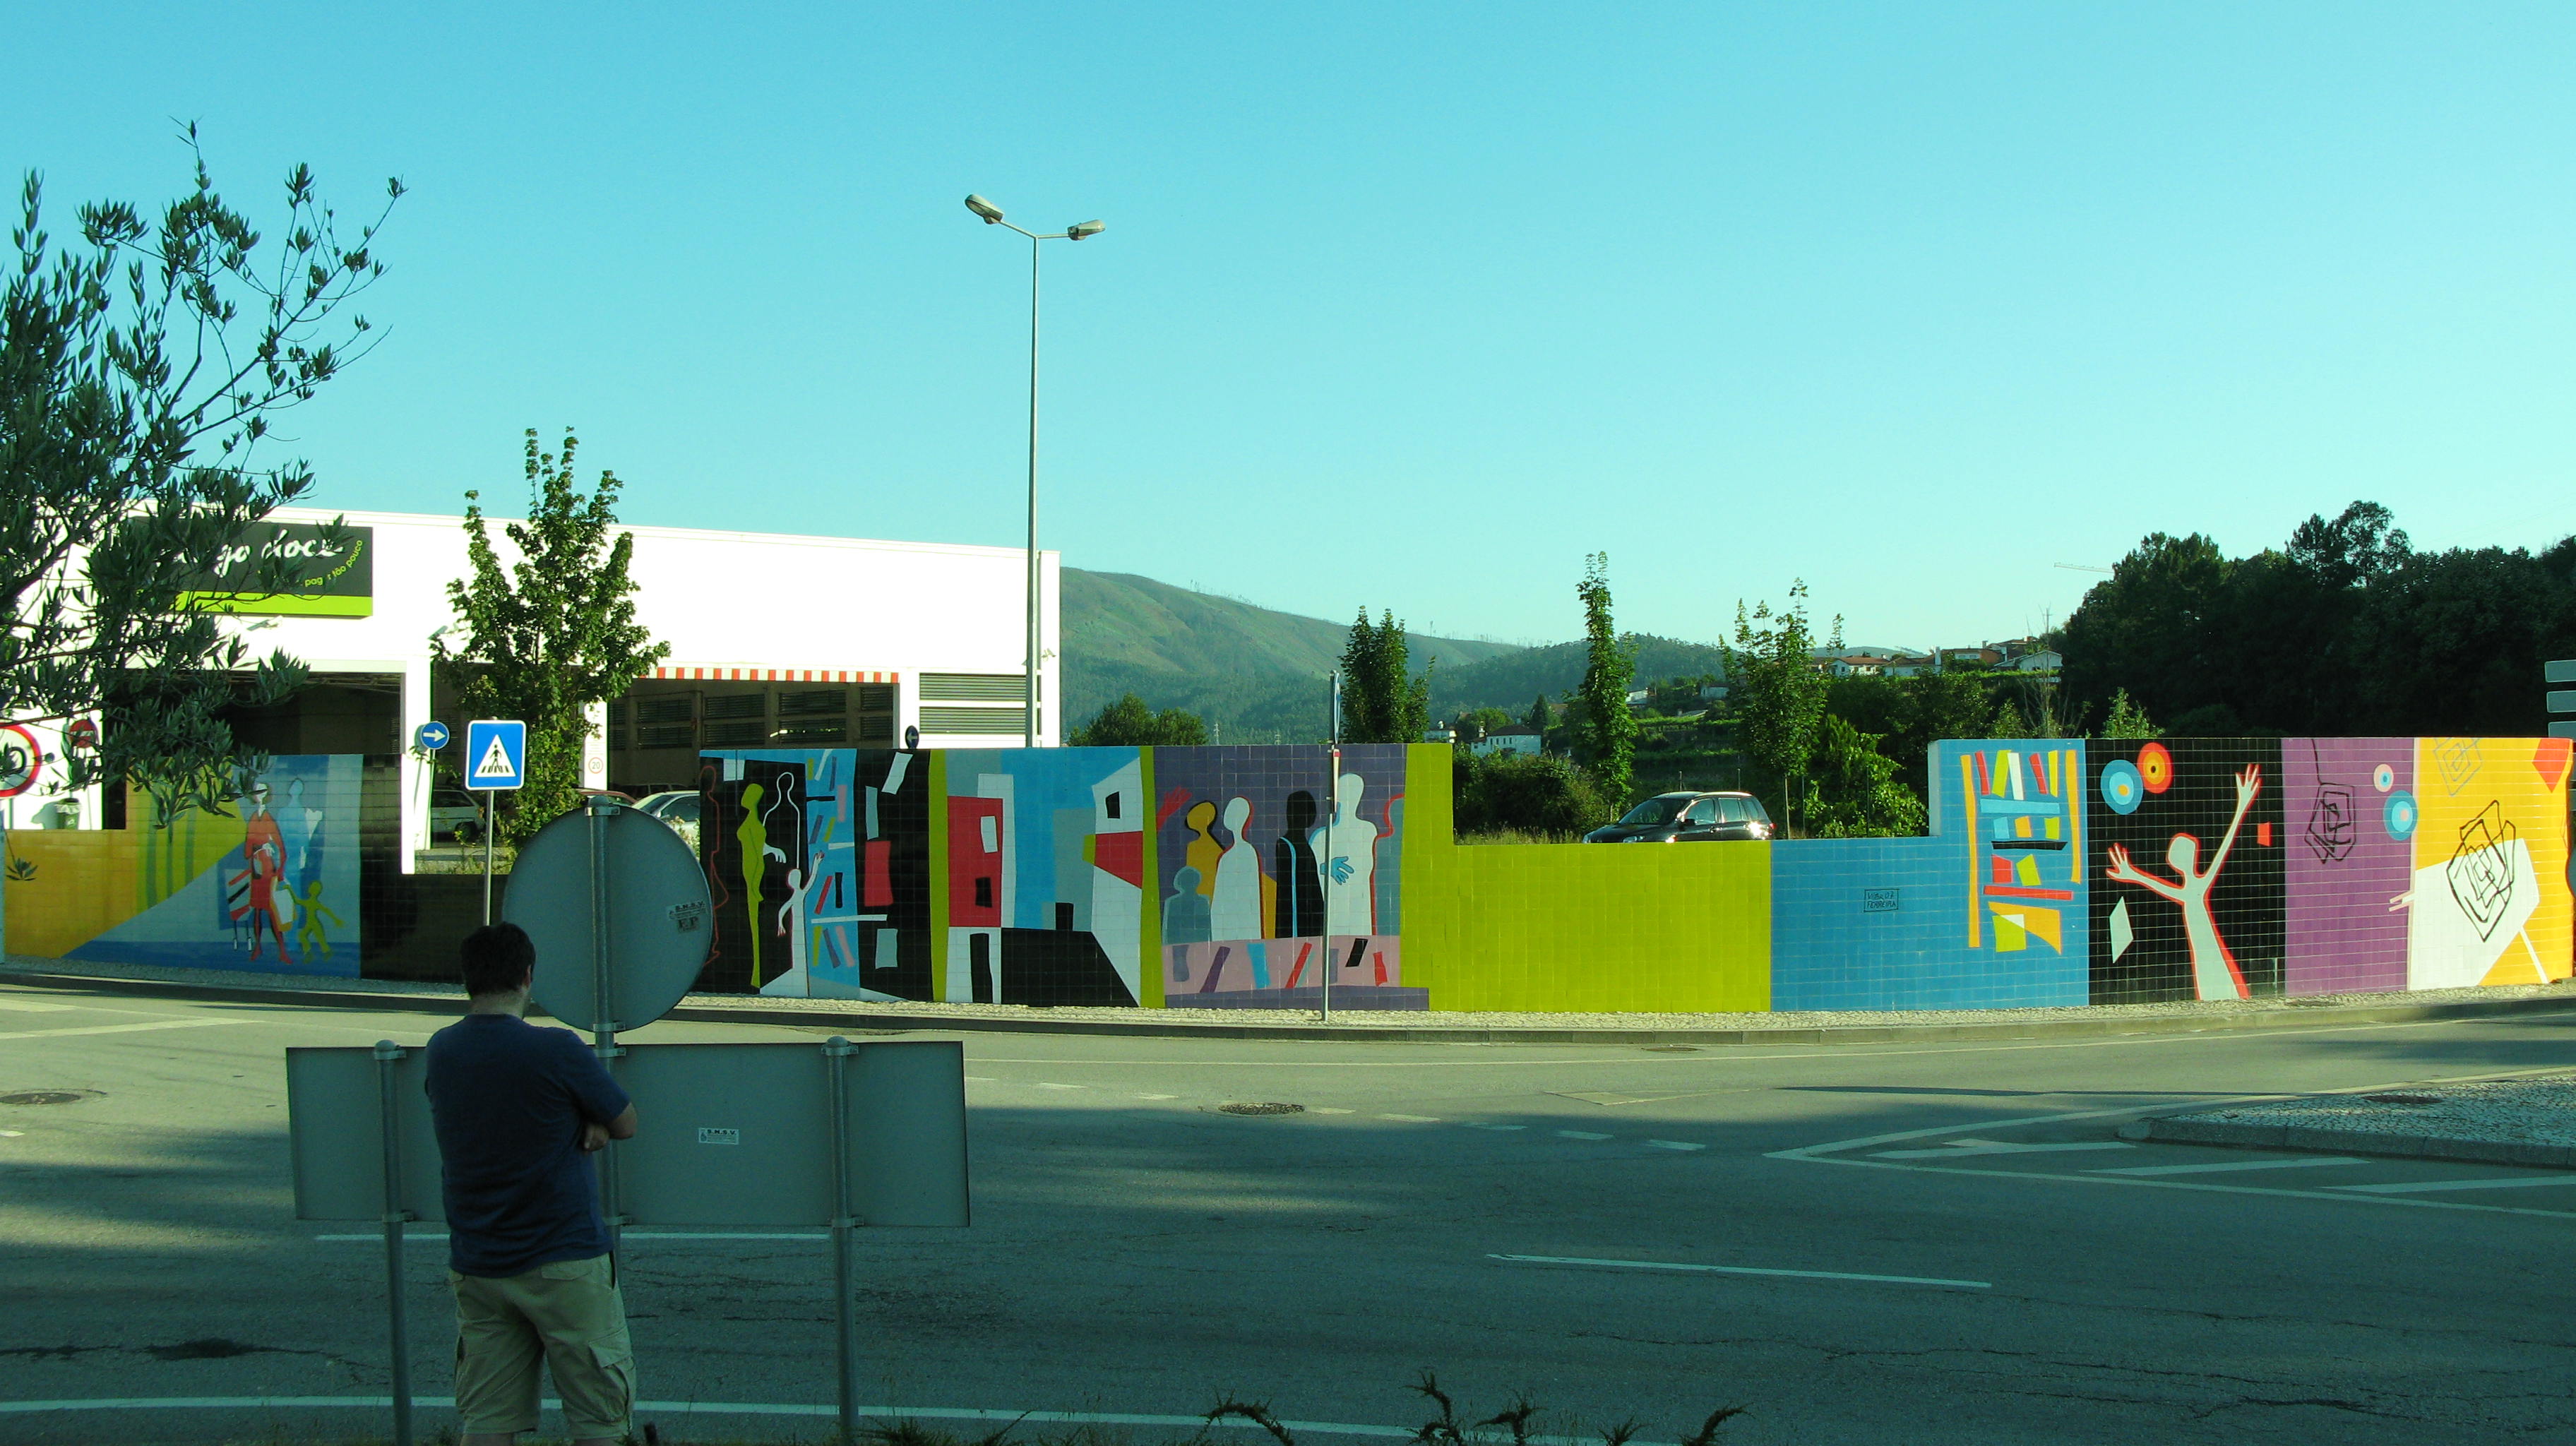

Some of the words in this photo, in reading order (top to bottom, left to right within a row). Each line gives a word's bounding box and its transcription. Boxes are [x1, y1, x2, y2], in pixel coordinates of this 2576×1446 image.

[304, 573, 332, 587] pagr
[332, 565, 346, 578] tão
[345, 540, 363, 568] pouco
[592, 761, 600, 770] 20
